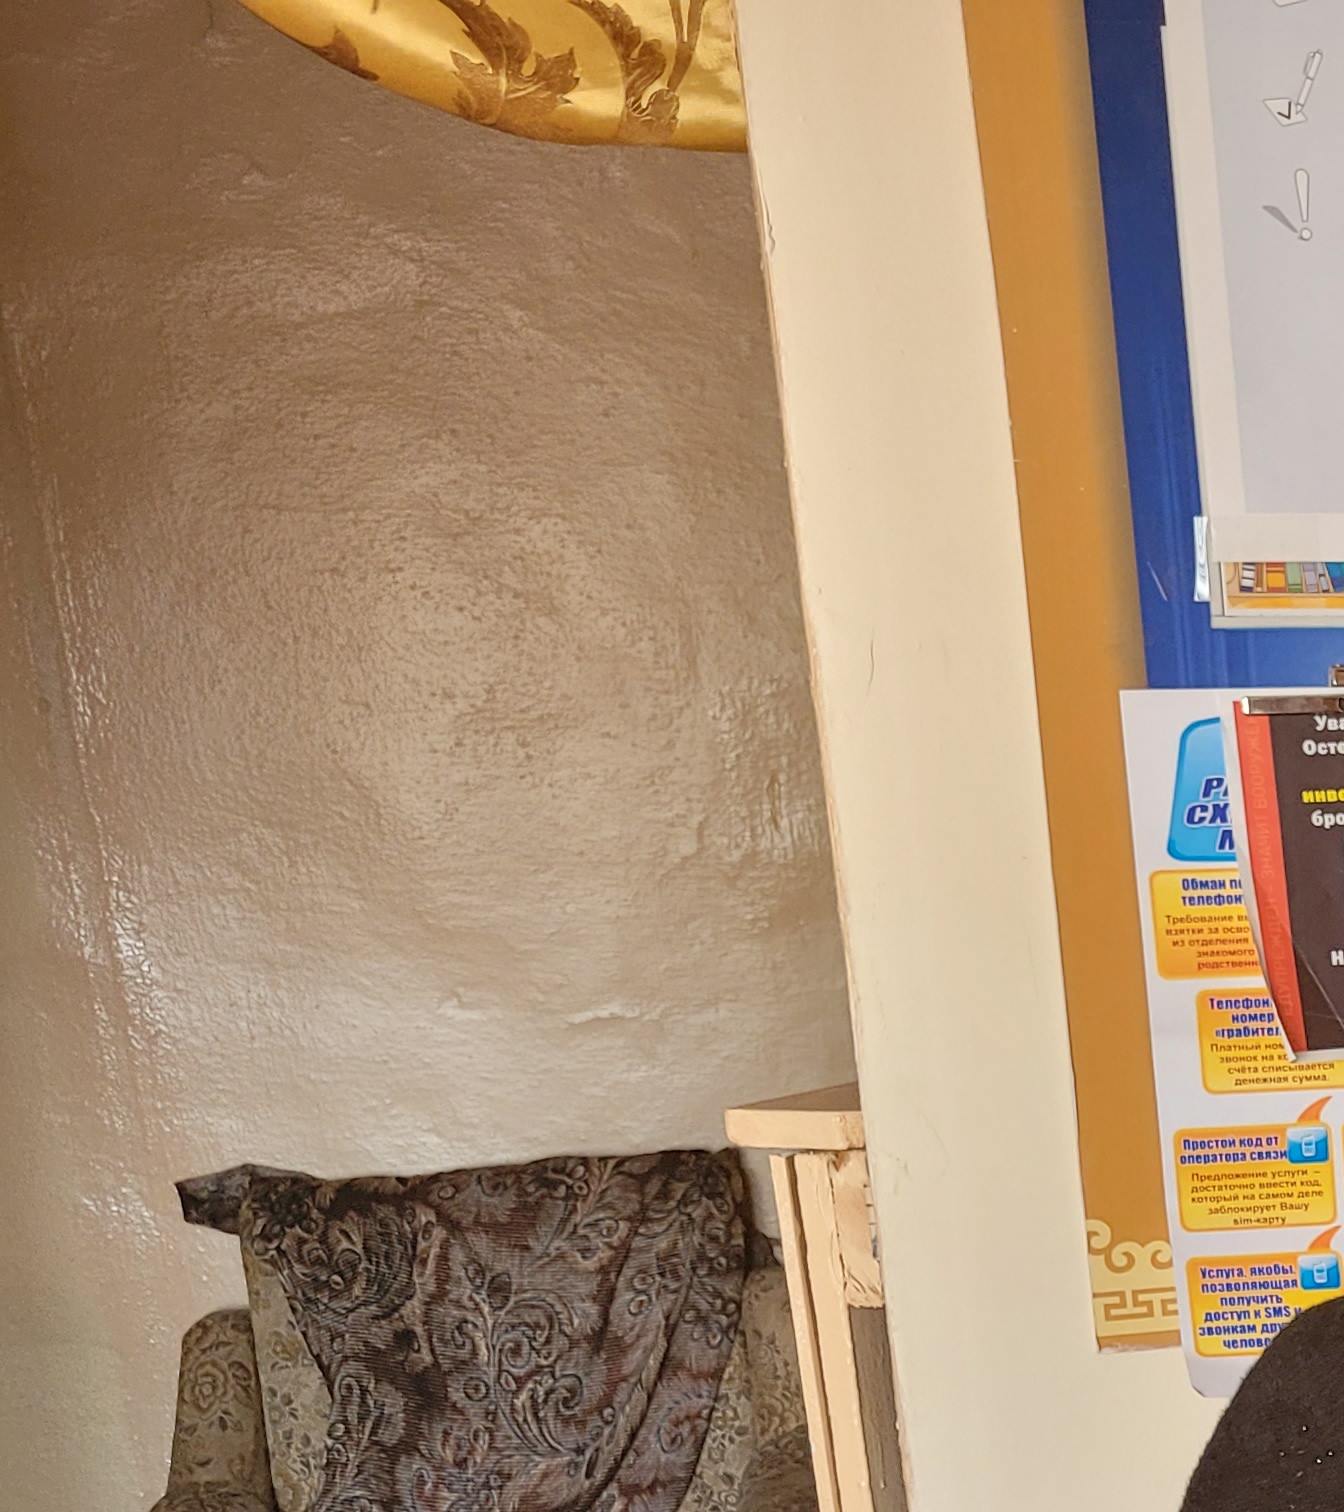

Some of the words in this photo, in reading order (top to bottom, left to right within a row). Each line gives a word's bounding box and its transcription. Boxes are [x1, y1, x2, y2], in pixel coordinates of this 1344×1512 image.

[1181, 878, 1226, 892] Обман
[1181, 893, 1244, 907] телефон
[1164, 914, 1234, 925] Требование
[1208, 927, 1219, 935] за
[1172, 939, 1185, 947] из
[1189, 937, 1249, 947] отделения
[1196, 949, 1255, 958] знакомого
[1209, 996, 1272, 1010] Телефон
[1232, 1012, 1275, 1024] номер
[1210, 1042, 1261, 1053] Платный
[1219, 1055, 1258, 1064] звонок
[1262, 1054, 1275, 1062] на
[1227, 1064, 1258, 1075] счёта
[1262, 1062, 1335, 1073] списывается
[1234, 1076, 1289, 1087] денежная
[1292, 1074, 1330, 1084] сумма.
[1183, 1137, 1236, 1151] Простой
[1239, 1136, 1264, 1147] код
[1266, 1136, 1278, 1146] от
[1180, 1152, 1247, 1165] оператора
[1250, 1150, 1288, 1161] связи
[1191, 1171, 1268, 1183] Предложение
[1271, 1169, 1308, 1179] услуги
[1191, 1182, 1256, 1193] достаточно
[1259, 1180, 1297, 1189] ввести
[1191, 1192, 1239, 1204] который
[1242, 1192, 1256, 1200] на
[1259, 1191, 1294, 1199] самом
[1297, 1190, 1324, 1198] деле
[1208, 1203, 1276, 1215] заблокирует
[1280, 1202, 1310, 1211] Вашу
[1233, 1216, 1286, 1225] sim-карту
[1200, 1267, 1248, 1279] Услуга,
[1202, 1278, 1298, 1293] позволяющая
[1220, 1294, 1283, 1306] получить
[1204, 1310, 1251, 1323] доступ
[1254, 1309, 1262, 1319] к
[1265, 1306, 1291, 1318] SMS
[1199, 1324, 1256, 1336] звонкам
